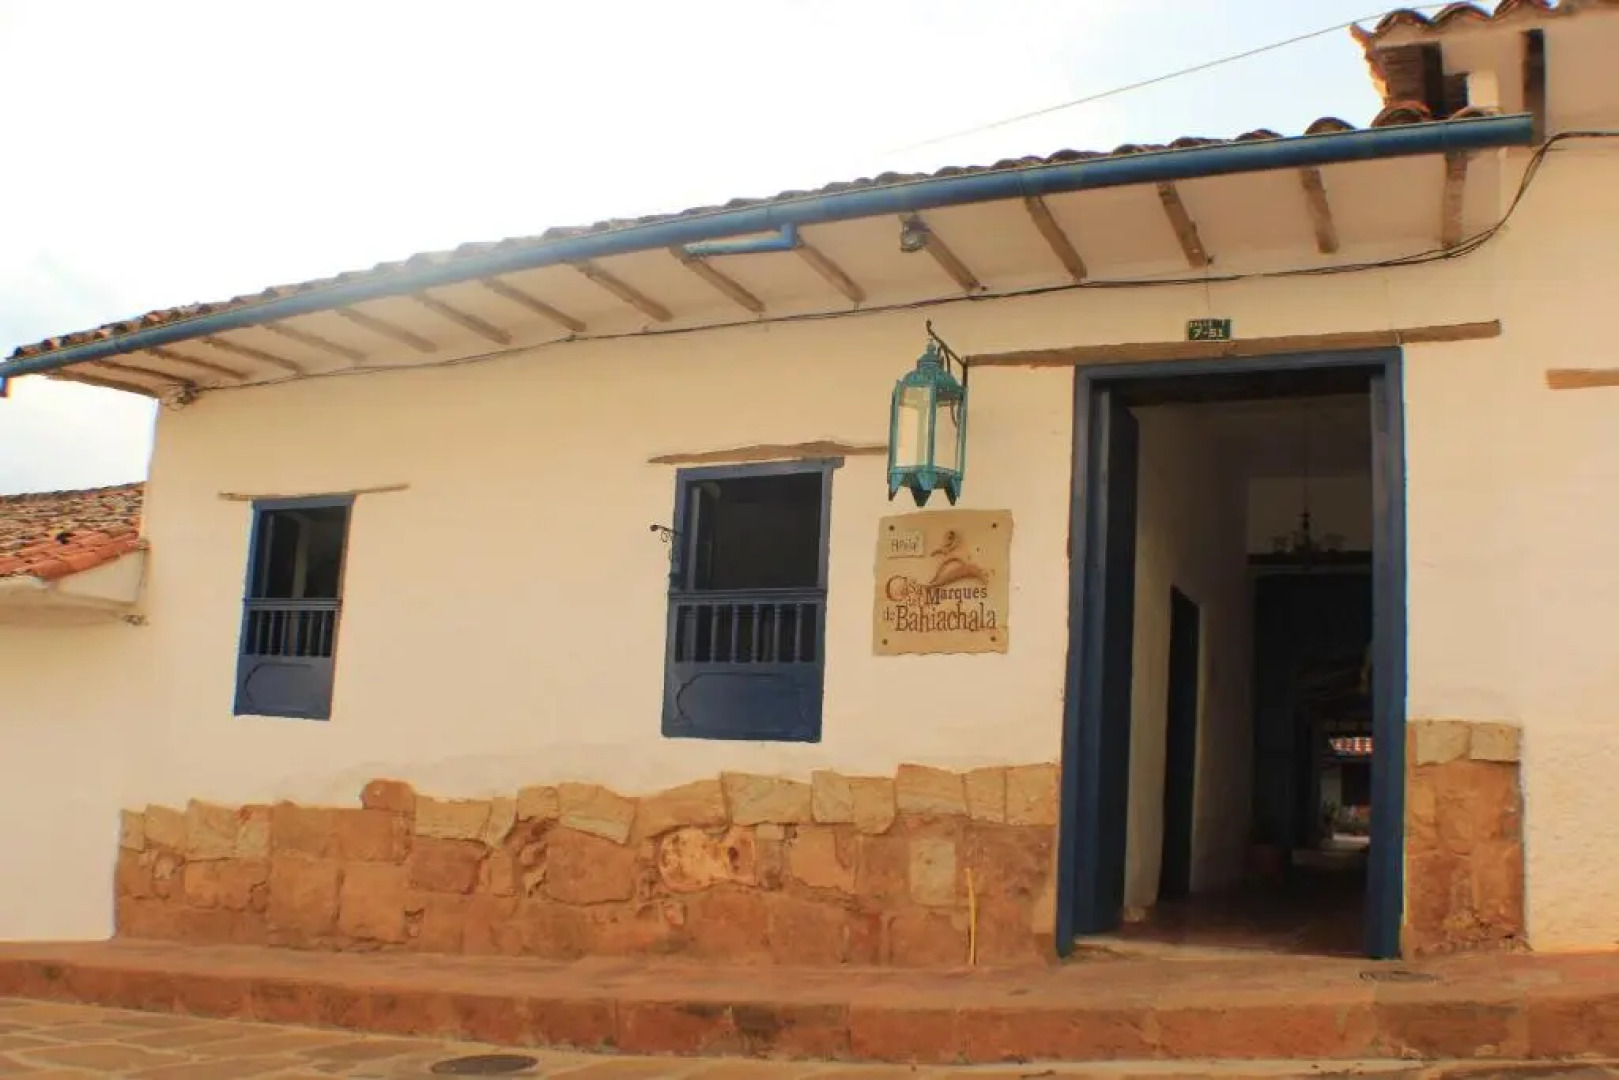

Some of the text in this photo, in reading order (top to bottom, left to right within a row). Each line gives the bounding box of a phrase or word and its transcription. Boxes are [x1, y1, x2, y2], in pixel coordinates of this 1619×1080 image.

[1193, 328, 1223, 337] 7-51
[886, 575, 922, 601] Casa
[925, 586, 988, 605] Marques
[895, 602, 996, 632] Bahiachala
